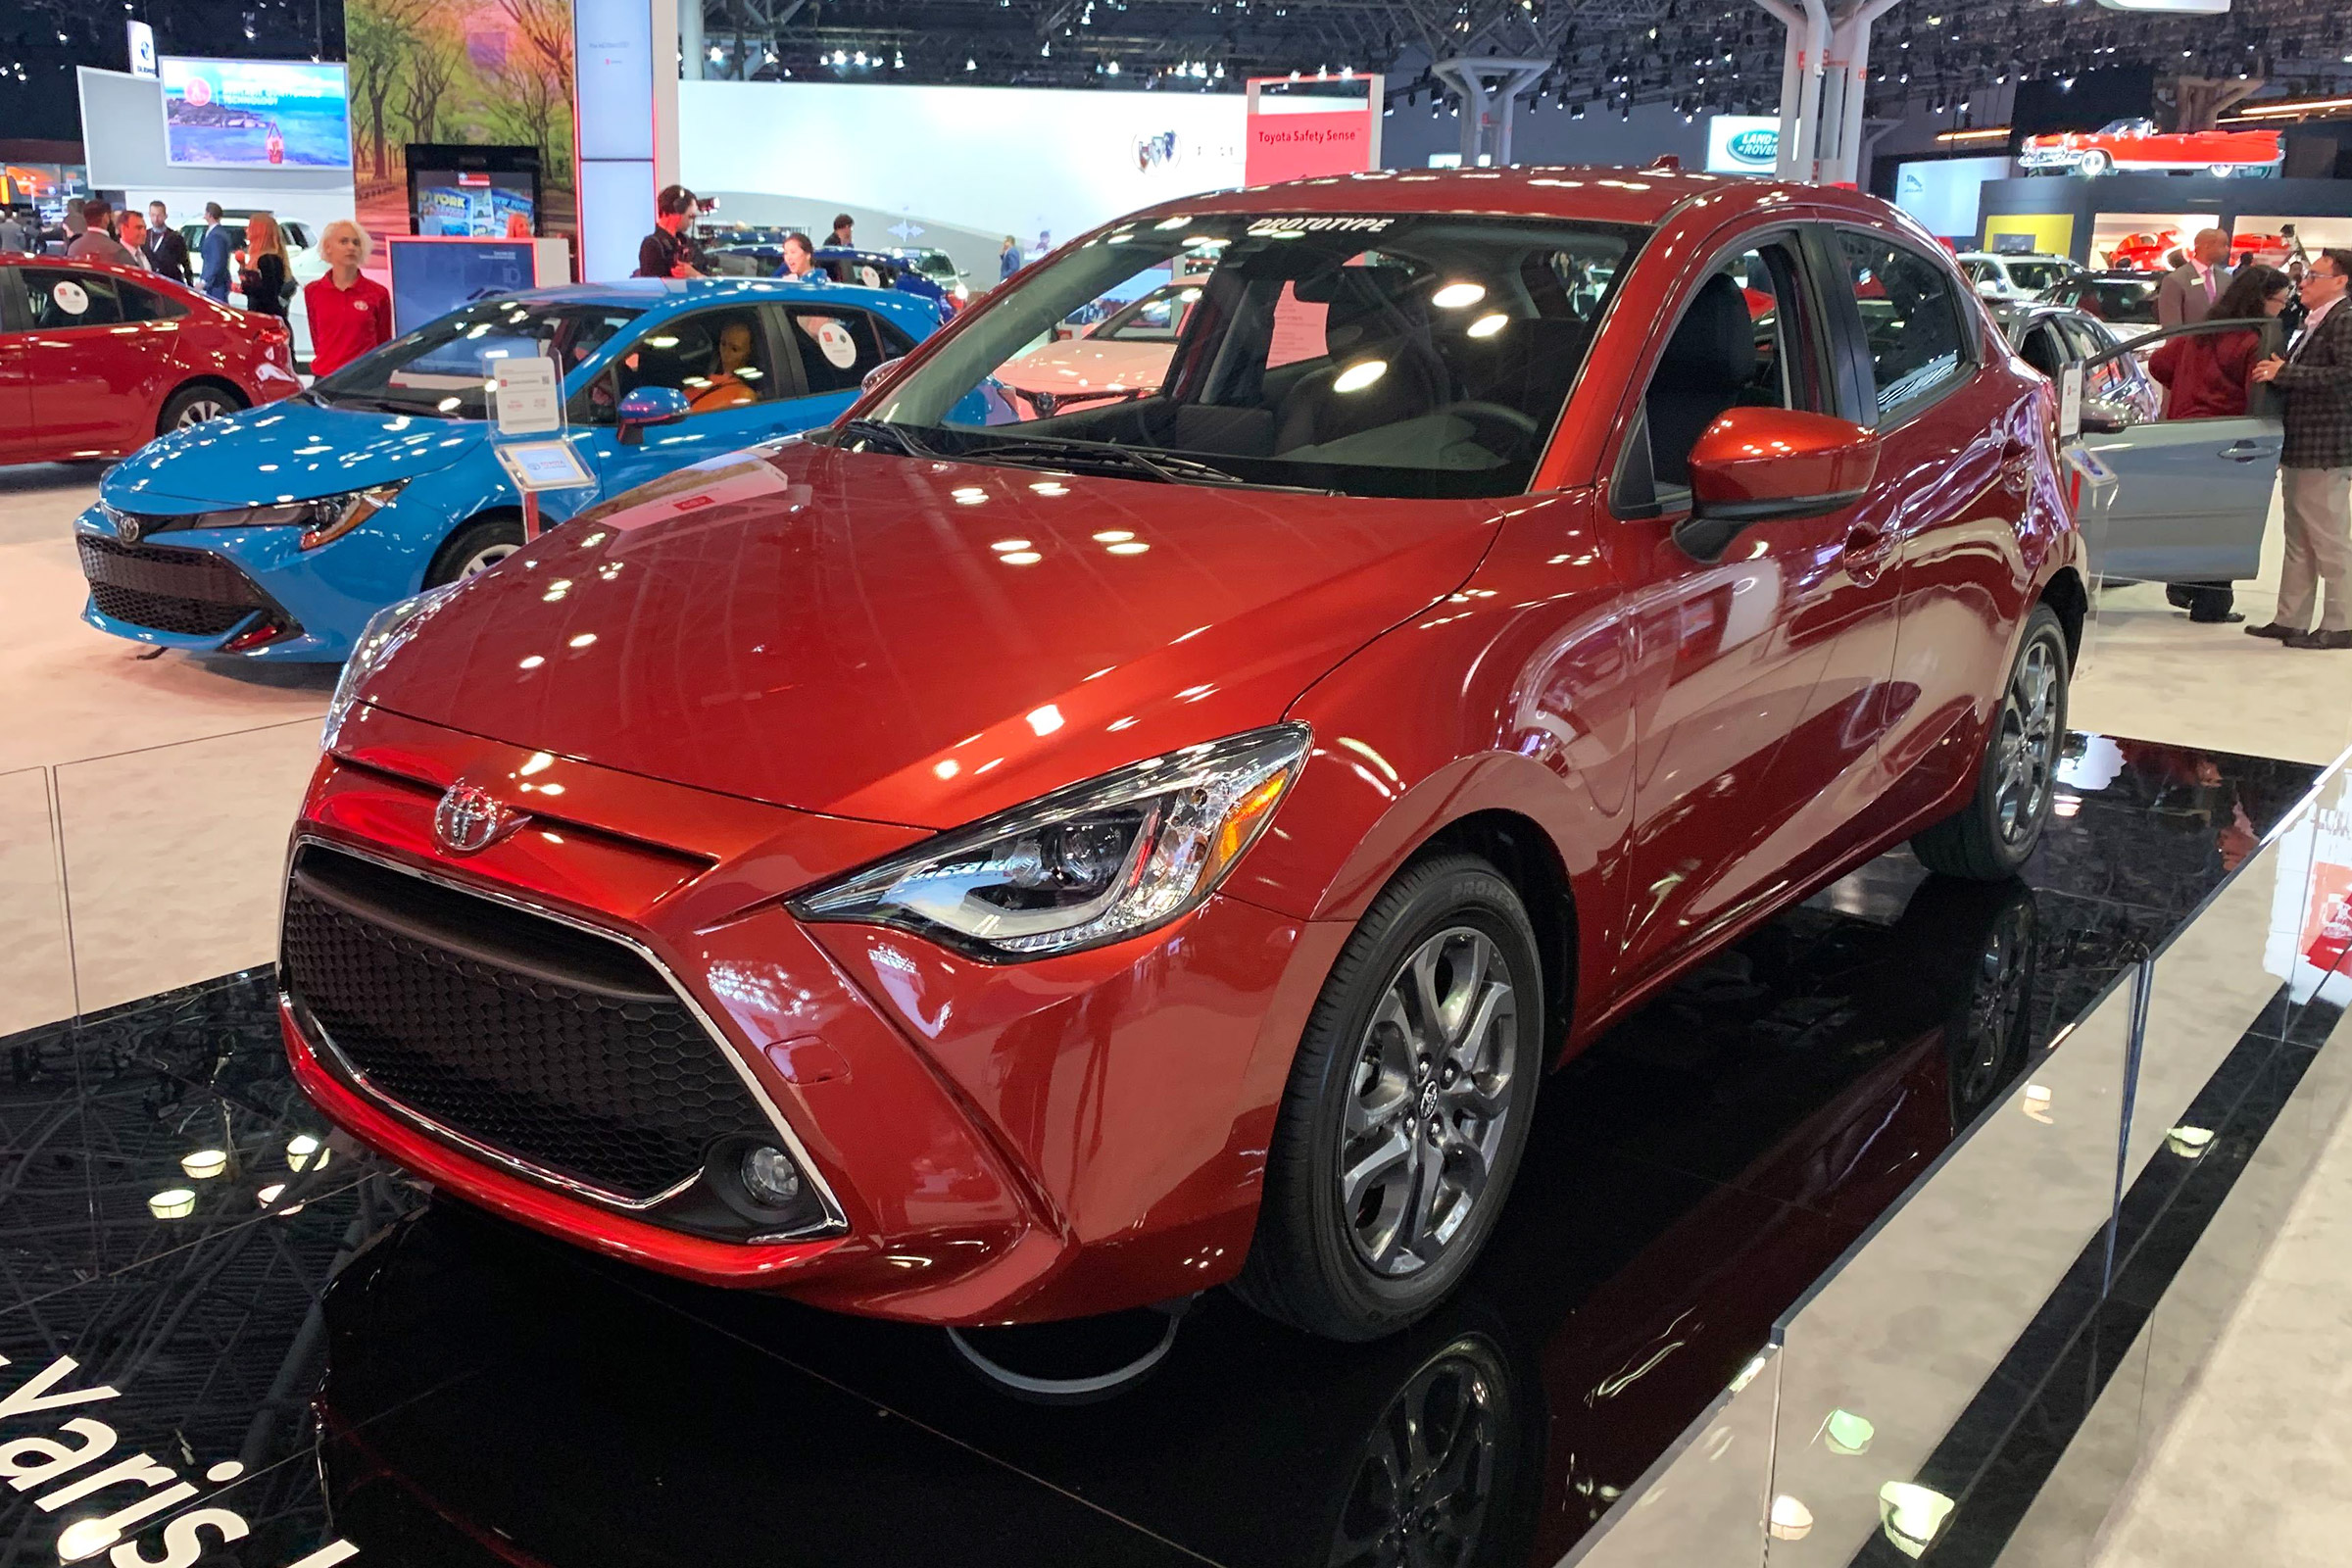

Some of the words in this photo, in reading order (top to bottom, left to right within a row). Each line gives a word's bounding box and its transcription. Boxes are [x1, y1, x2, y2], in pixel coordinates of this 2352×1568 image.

[1258, 131, 1292, 145] Toyota
[1294, 129, 1324, 144] Safety
[1327, 129, 1355, 141] Sense
[1741, 133, 1773, 145] LAND
[1247, 218, 1396, 233] PROTOTYPE
